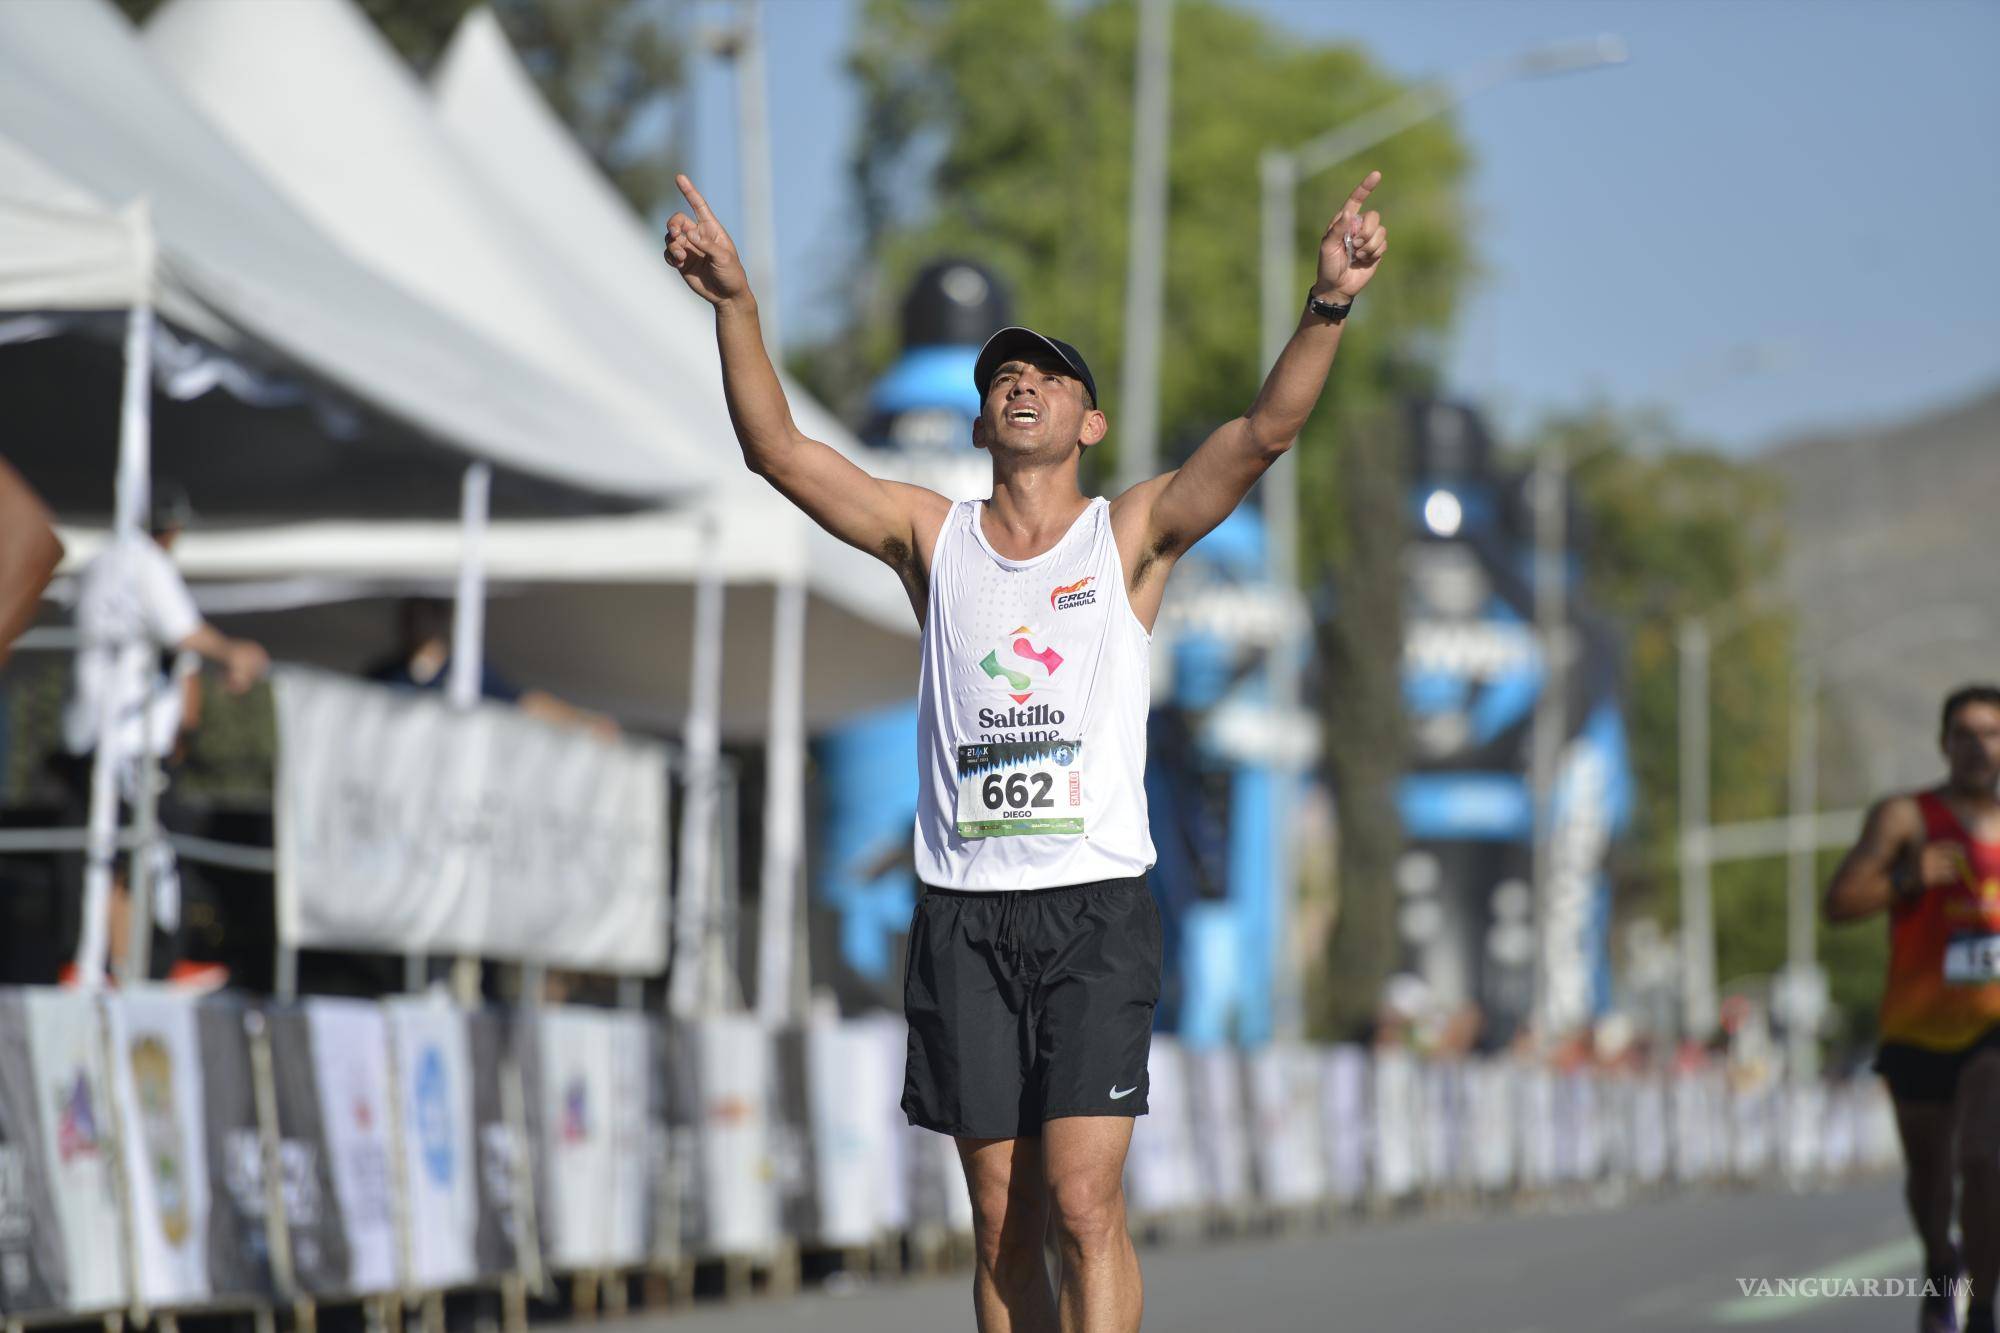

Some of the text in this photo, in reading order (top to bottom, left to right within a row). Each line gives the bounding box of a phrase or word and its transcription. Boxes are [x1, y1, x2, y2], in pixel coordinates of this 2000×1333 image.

[1058, 590, 1096, 604] CROC
[1058, 597, 1096, 610] COAHUILA
[978, 704, 1065, 729] Saltillo
[982, 772, 1054, 810] 662
[1003, 810, 1032, 818] DIEGO
